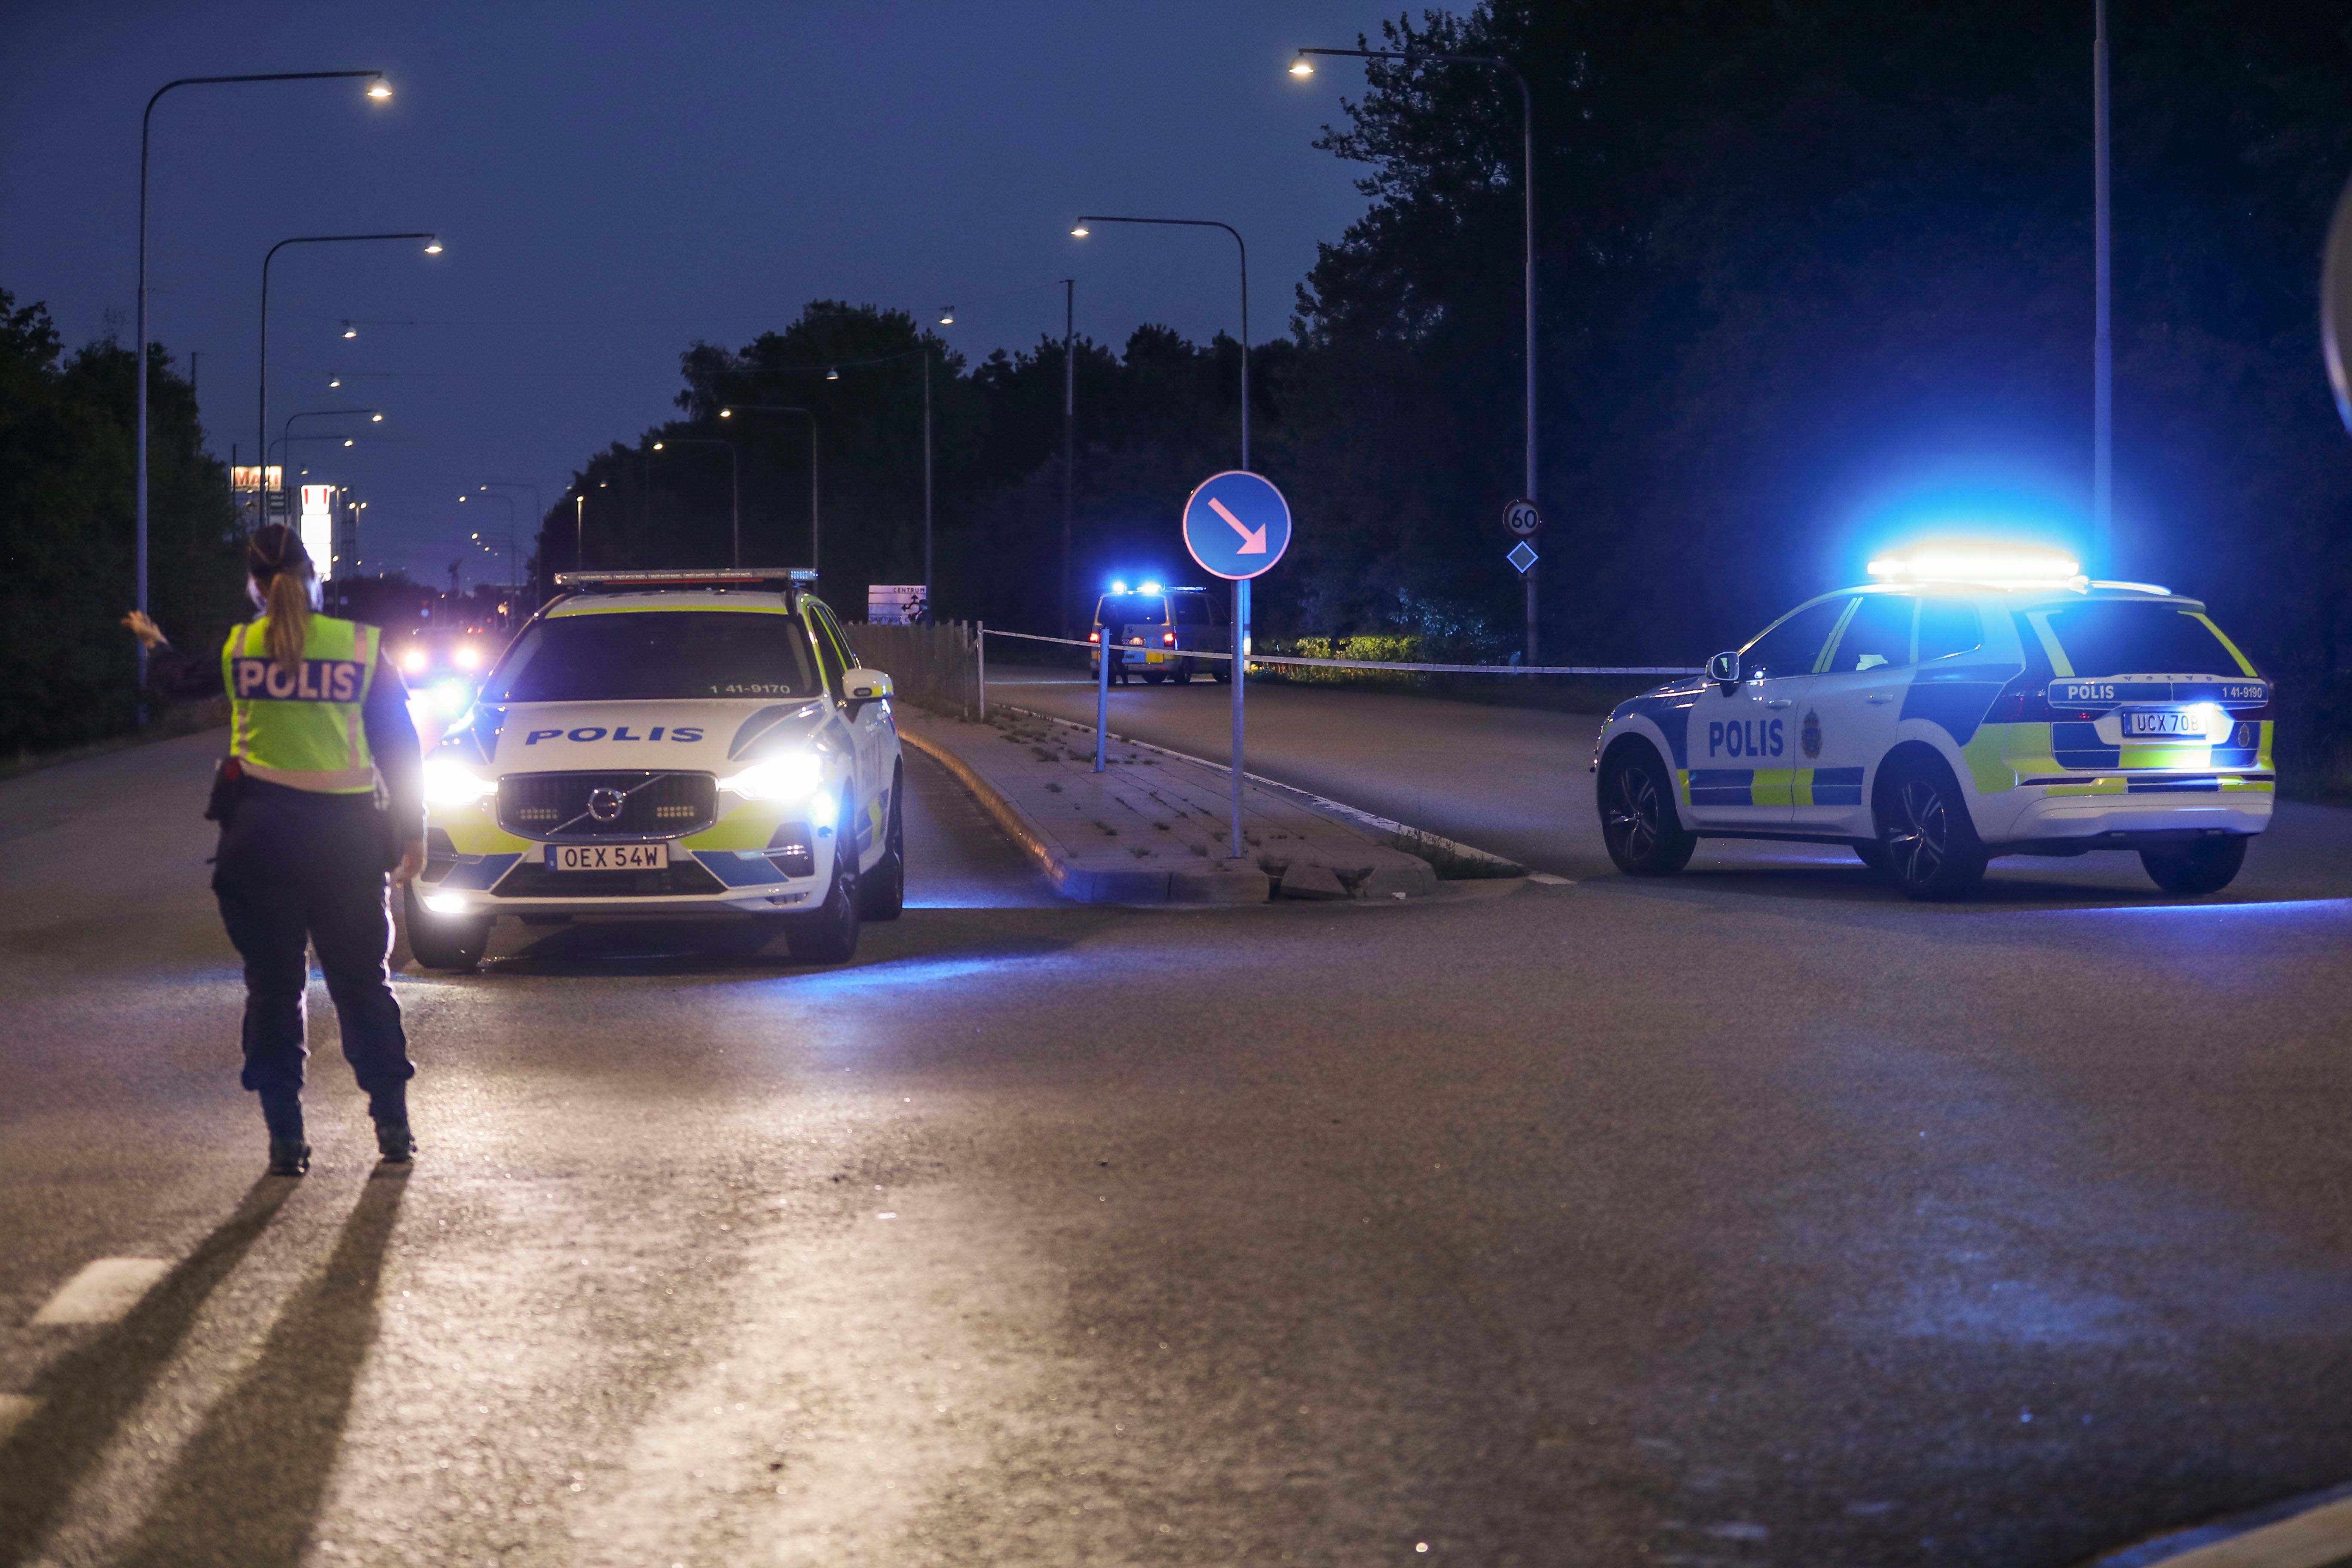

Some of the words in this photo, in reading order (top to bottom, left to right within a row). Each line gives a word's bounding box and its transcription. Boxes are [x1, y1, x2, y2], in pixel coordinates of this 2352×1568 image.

[234, 471, 278, 485] MAI
[1512, 509, 1537, 529] 60
[238, 662, 356, 700] POLIS
[710, 685, 718, 694] 1
[726, 684, 790, 694] 41-9170
[2068, 686, 2114, 699] POLIS
[2223, 687, 2227, 698] 1
[2231, 687, 2262, 698] 41-9190
[2138, 715, 2166, 732] UCX
[2171, 715, 2199, 732] 70B
[525, 727, 704, 745] POLIS
[1709, 719, 1784, 757] POLIS
[565, 848, 606, 867] OEX
[615, 847, 657, 867] 54W
